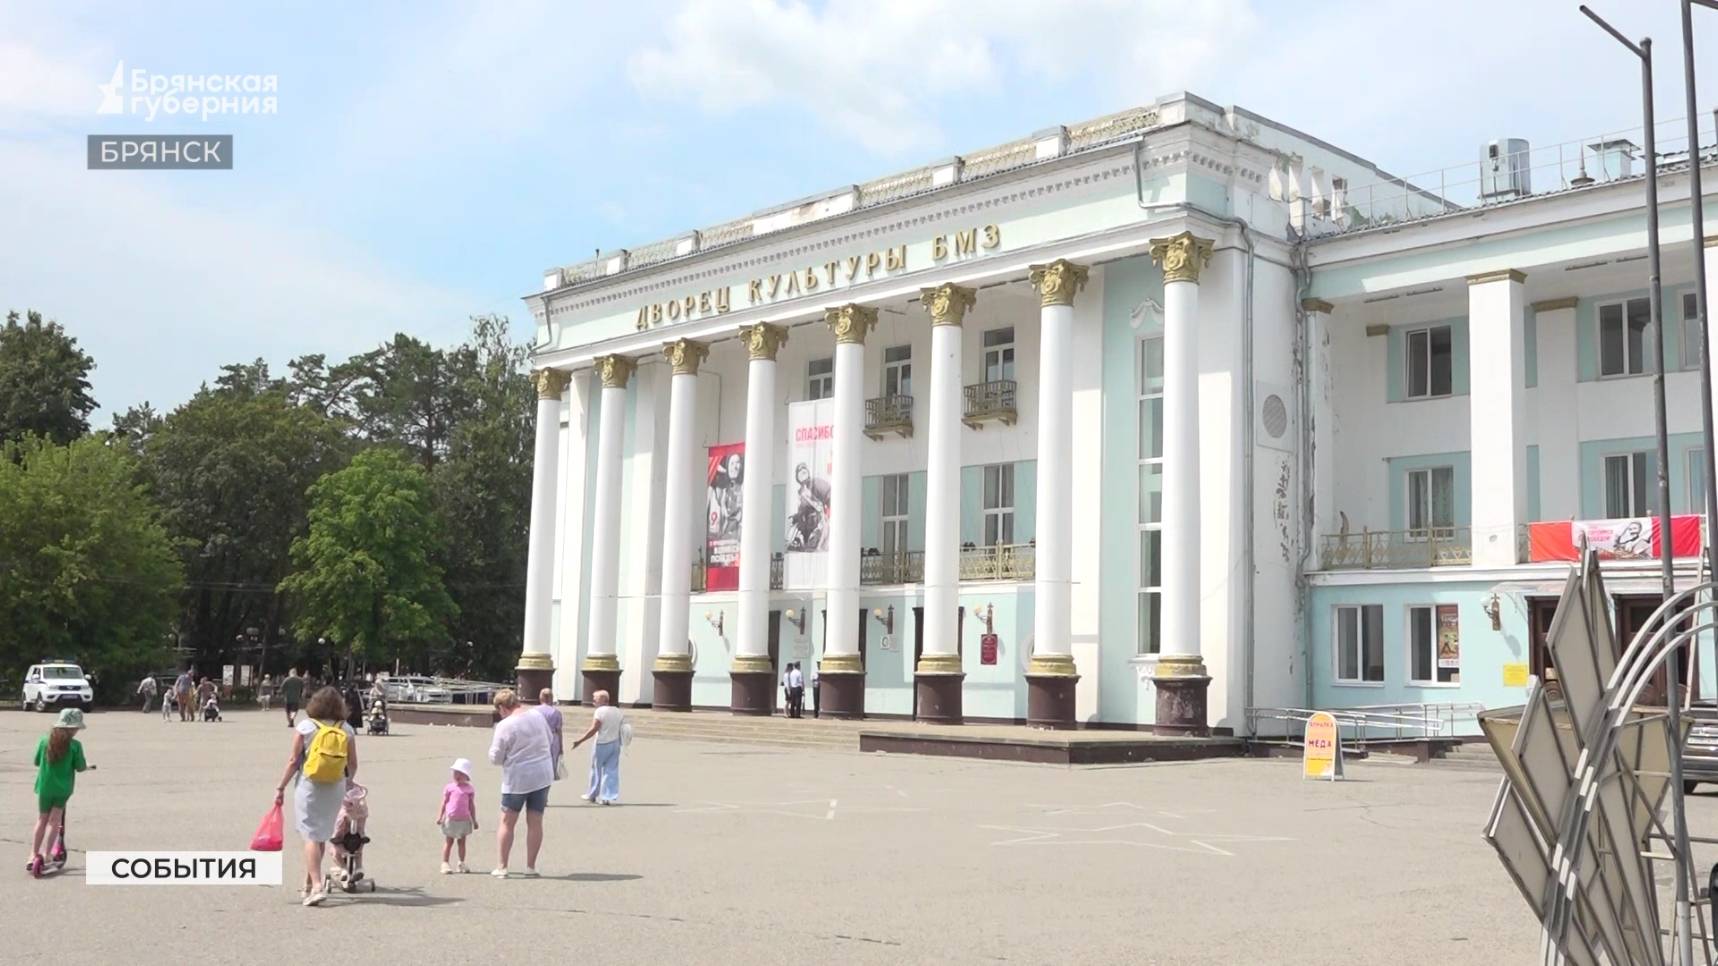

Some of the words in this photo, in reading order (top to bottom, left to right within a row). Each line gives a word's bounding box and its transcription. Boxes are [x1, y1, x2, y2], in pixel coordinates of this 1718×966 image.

[635, 288, 731, 330] ДВОРЕЦ
[747, 246, 907, 302] КУЛЬТУРЫ
[931, 223, 1001, 260] БМЗ
[1308, 739, 1332, 748] МЕДА
